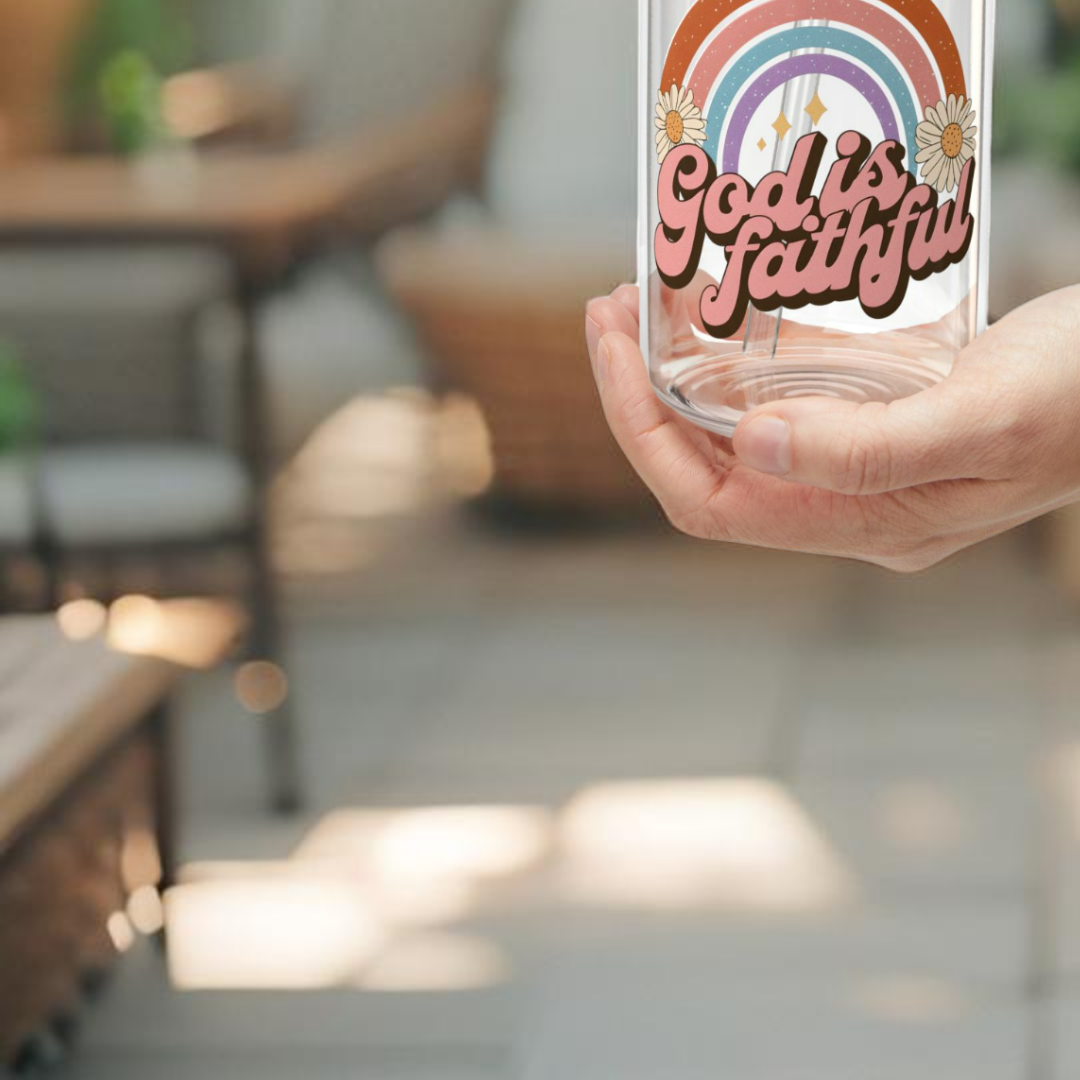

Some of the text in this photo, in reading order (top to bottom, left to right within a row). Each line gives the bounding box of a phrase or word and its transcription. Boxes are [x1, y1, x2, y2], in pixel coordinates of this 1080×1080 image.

[654, 129, 916, 289] God is
[699, 156, 976, 338] faithful
